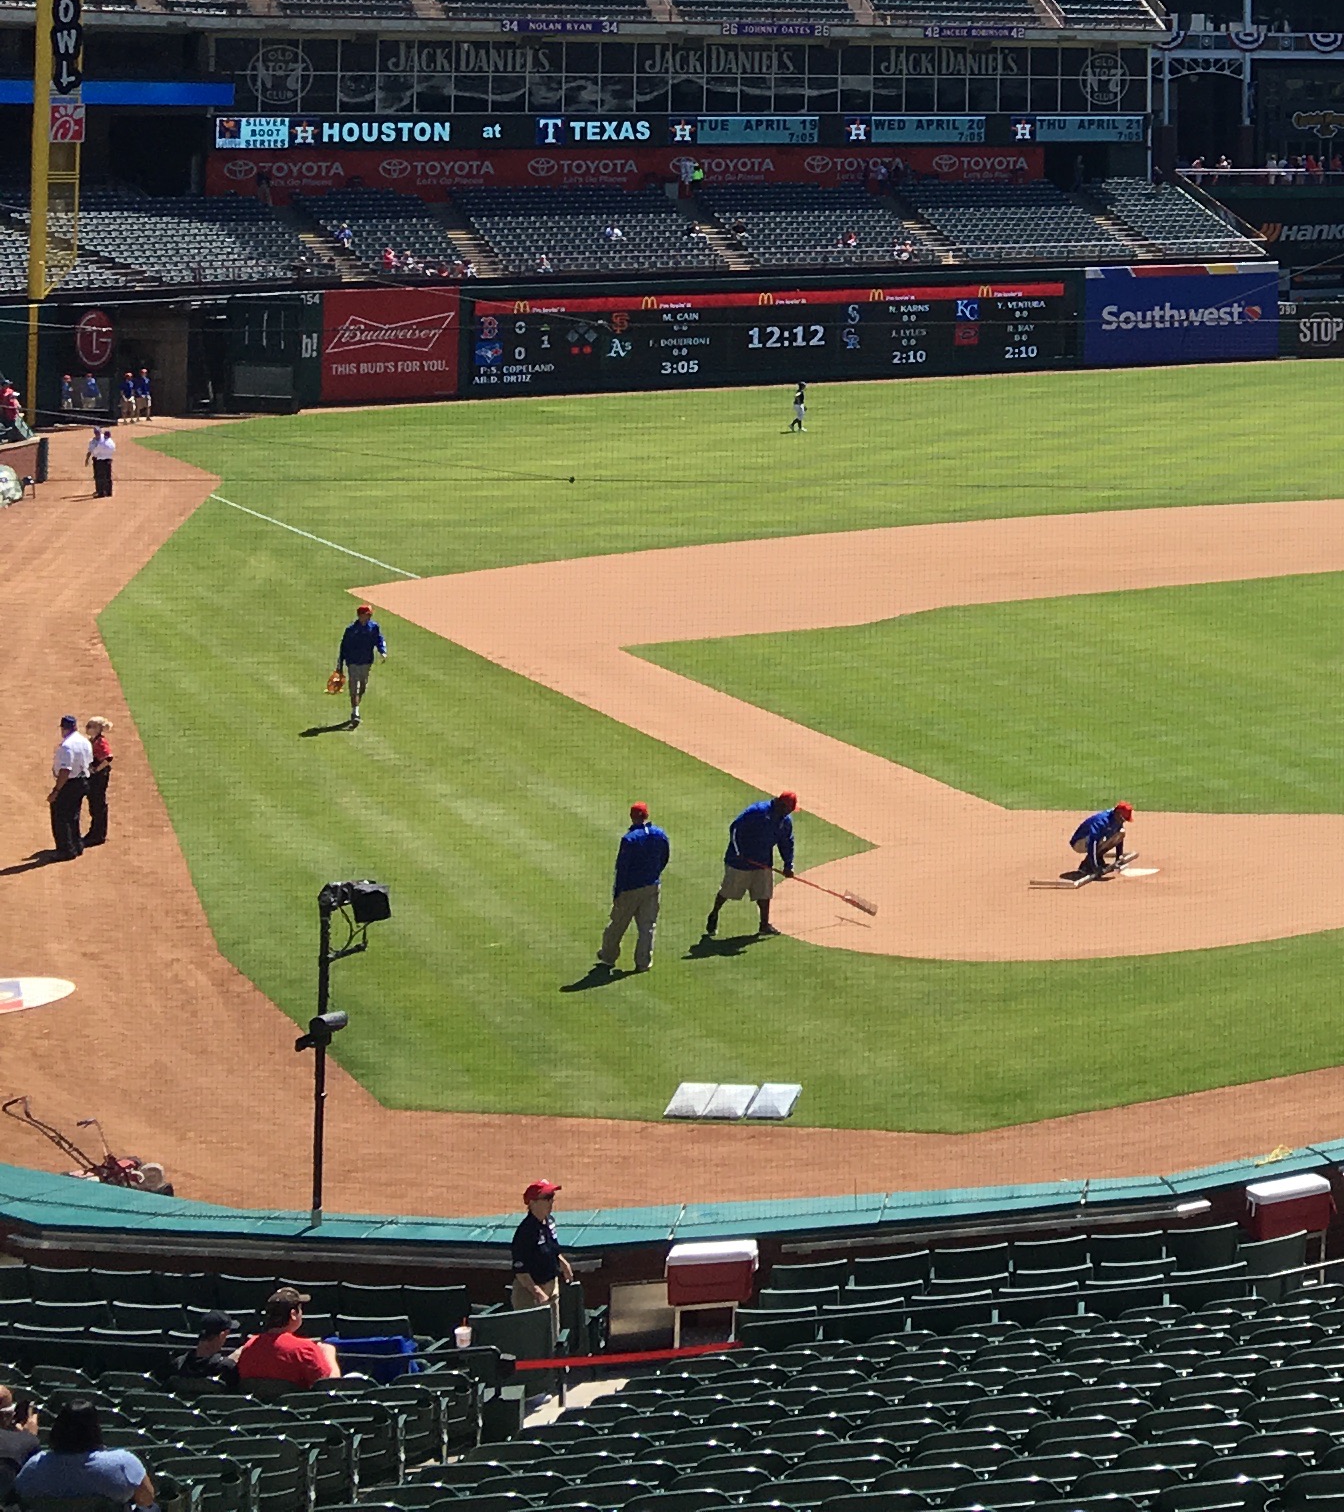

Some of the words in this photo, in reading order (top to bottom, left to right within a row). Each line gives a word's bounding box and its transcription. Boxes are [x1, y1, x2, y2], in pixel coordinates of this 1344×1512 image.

[502, 20, 519, 32] 34
[528, 22, 563, 31] NOLAN
[566, 22, 593, 31] RYAN
[601, 21, 618, 34] 34
[722, 23, 739, 35] 26
[742, 25, 778, 34] JOHNNY
[781, 26, 811, 34] OATES
[814, 25, 830, 36] 26
[925, 26, 940, 38] 42
[1010, 27, 1026, 39] 42
[387, 41, 452, 73] JACK
[459, 42, 551, 73] DANIEL'S
[644, 44, 703, 74] JACK
[710, 44, 795, 74] DANIEL'S
[880, 46, 935, 75] JACK
[940, 46, 1018, 75] DANIEL'S
[245, 118, 287, 128] SILVER
[698, 119, 730, 131] TUE
[743, 119, 791, 131] APRIL
[873, 119, 907, 131] WED
[915, 119, 960, 131] APRIL
[967, 119, 985, 131] 20
[1038, 119, 1069, 131] THU
[1077, 119, 1121, 131] APRIL
[1127, 119, 1143, 131] 21
[249, 129, 281, 138] BOOT
[322, 121, 451, 143] HOUSTON
[482, 123, 502, 140] at
[568, 119, 651, 141] TEXAS
[788, 132, 815, 143] 7:05
[957, 131, 983, 142] 7:05
[1117, 131, 1141, 141] 7:05
[258, 161, 345, 178] TOYOTA
[412, 160, 495, 177] TOYOTA
[559, 159, 638, 174] TOYOTA
[701, 157, 775, 173] TOYOTA
[960, 156, 1029, 171] TOYOTA
[676, 312, 700, 321] CAIN
[1101, 301, 1243, 331] Southwest
[338, 323, 444, 344] Budweiser
[747, 324, 826, 349] 12:12
[1298, 317, 1344, 344] STOP
[891, 349, 927, 364] 2:10
[1004, 344, 1039, 360] 2:10
[331, 362, 358, 376] THIS
[359, 361, 396, 375] BUD'S
[397, 360, 421, 374] FOR
[660, 359, 700, 374] 3:05
